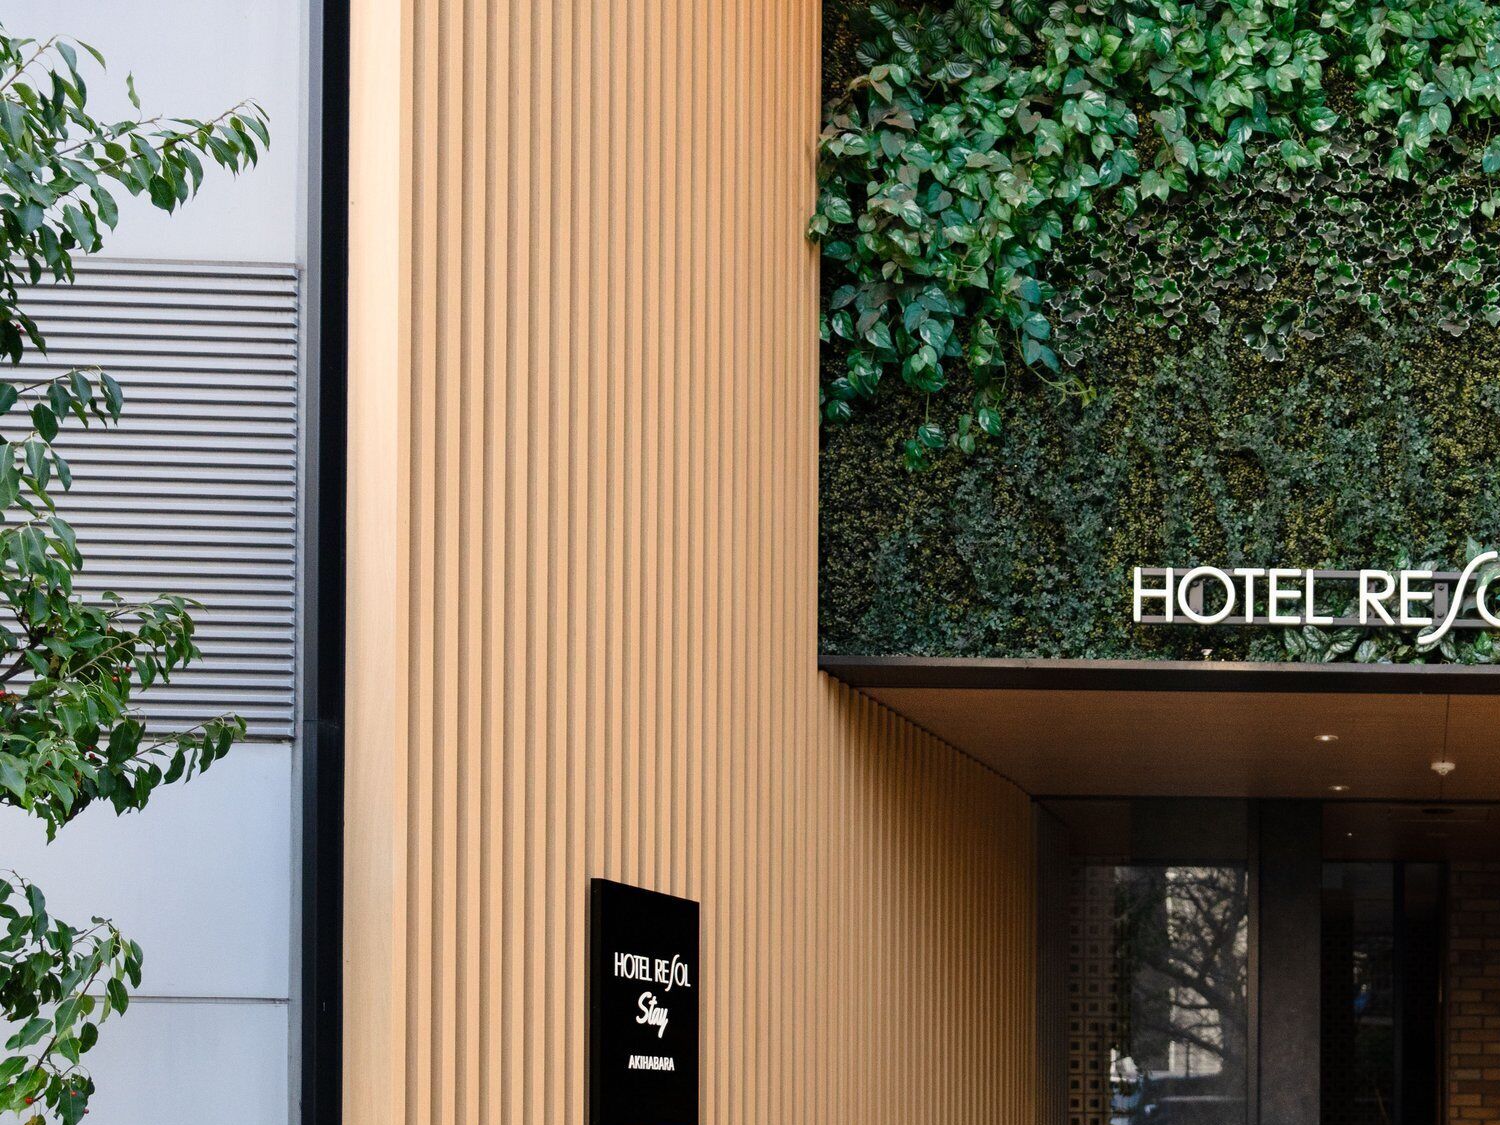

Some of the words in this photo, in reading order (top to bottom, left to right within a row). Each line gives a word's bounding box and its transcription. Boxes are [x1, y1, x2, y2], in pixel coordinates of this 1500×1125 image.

[1133, 566, 1334, 624] HOTEL
[614, 951, 653, 982] HOTEL
[654, 953, 692, 992] RESOL
[635, 991, 669, 1039] Stay
[628, 1054, 675, 1071] AKIHABARA
